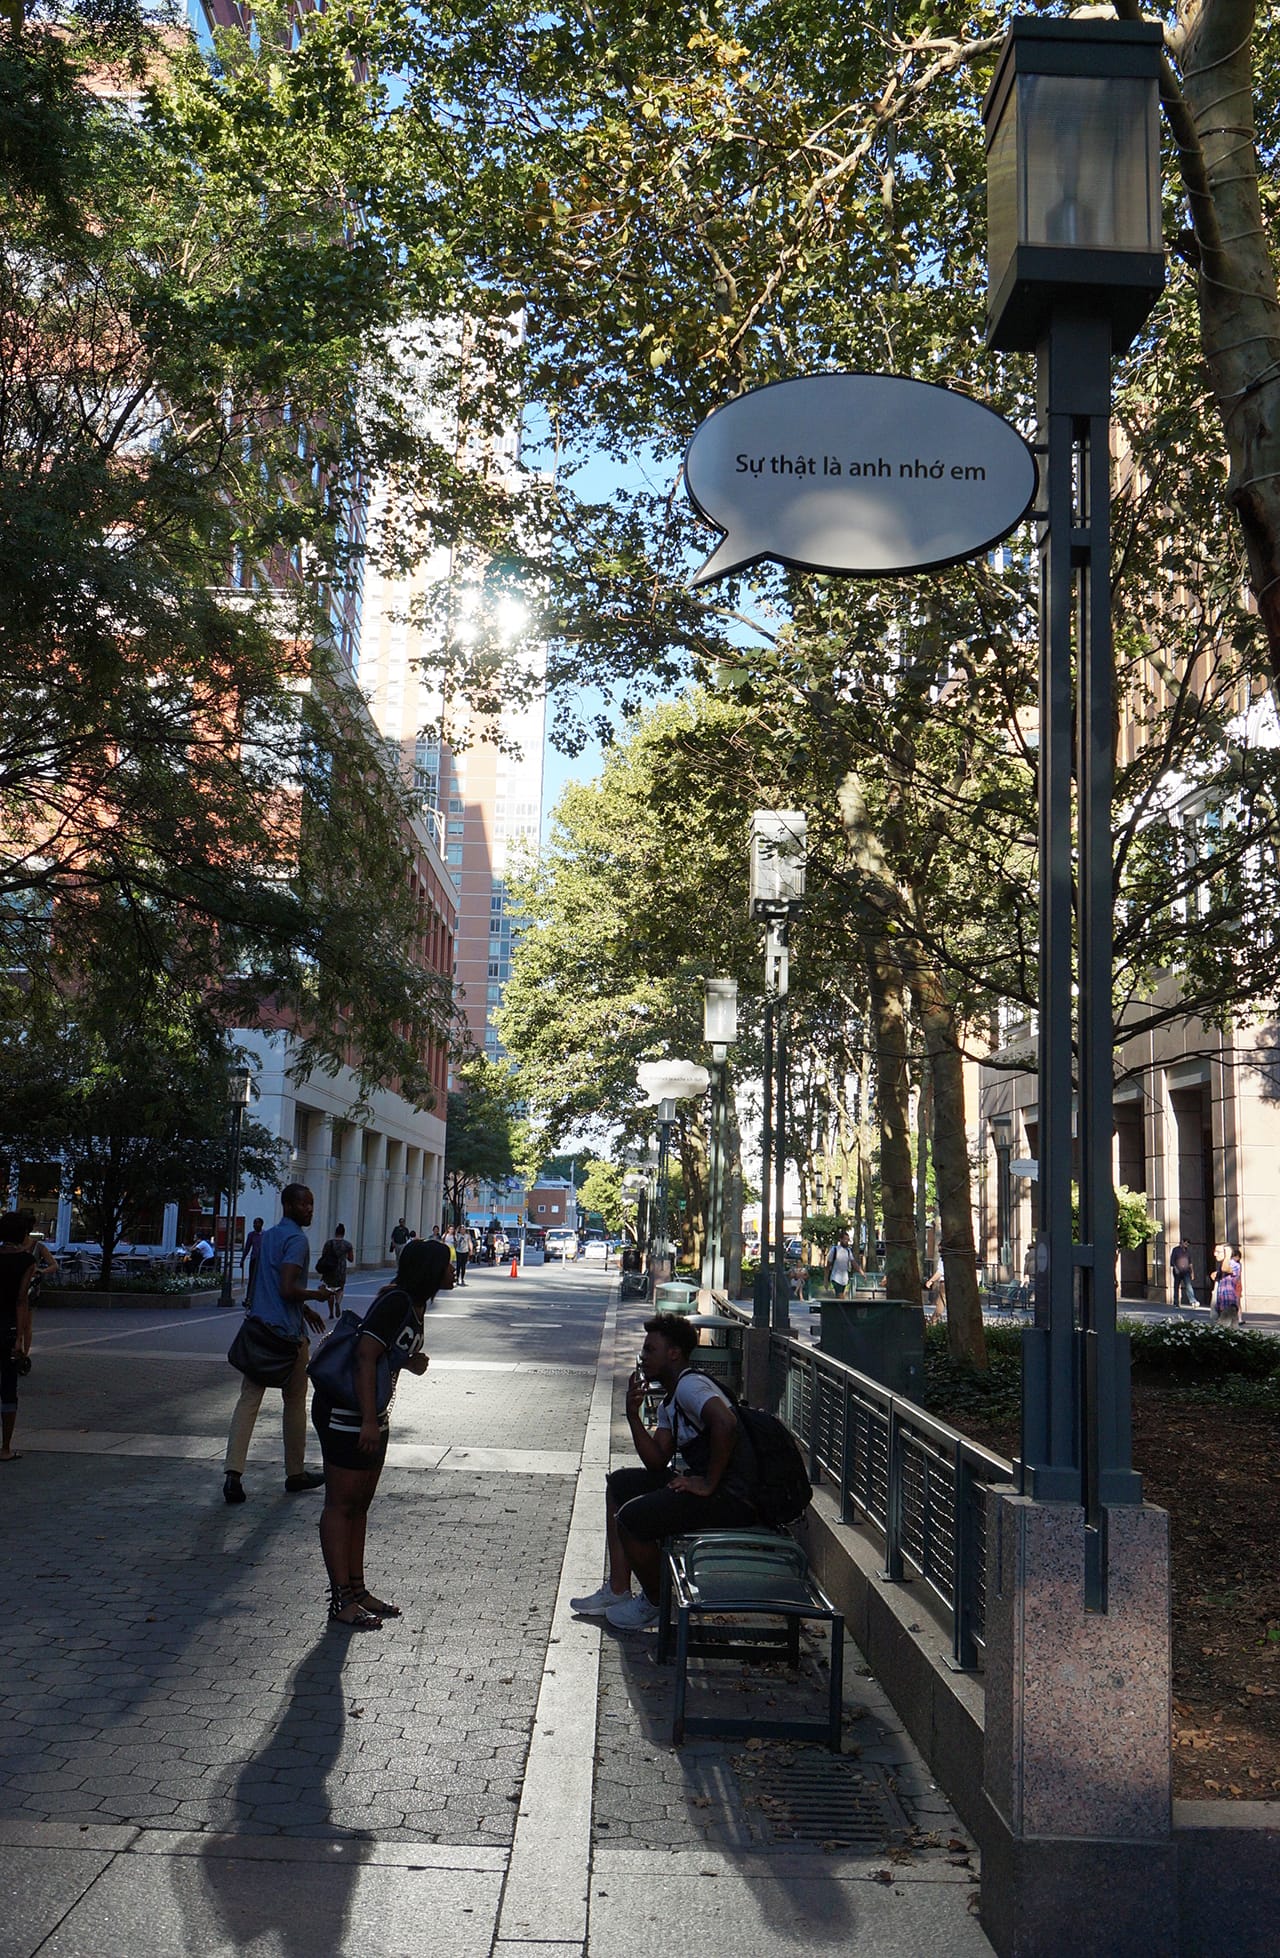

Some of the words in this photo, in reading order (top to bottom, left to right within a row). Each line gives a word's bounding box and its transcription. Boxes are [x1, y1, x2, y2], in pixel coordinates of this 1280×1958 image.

[735, 453, 765, 479] Sự
[770, 455, 816, 480] thật
[823, 455, 842, 476] là
[849, 457, 892, 478] anh
[899, 458, 945, 480] nhớ
[950, 465, 986, 481] em
